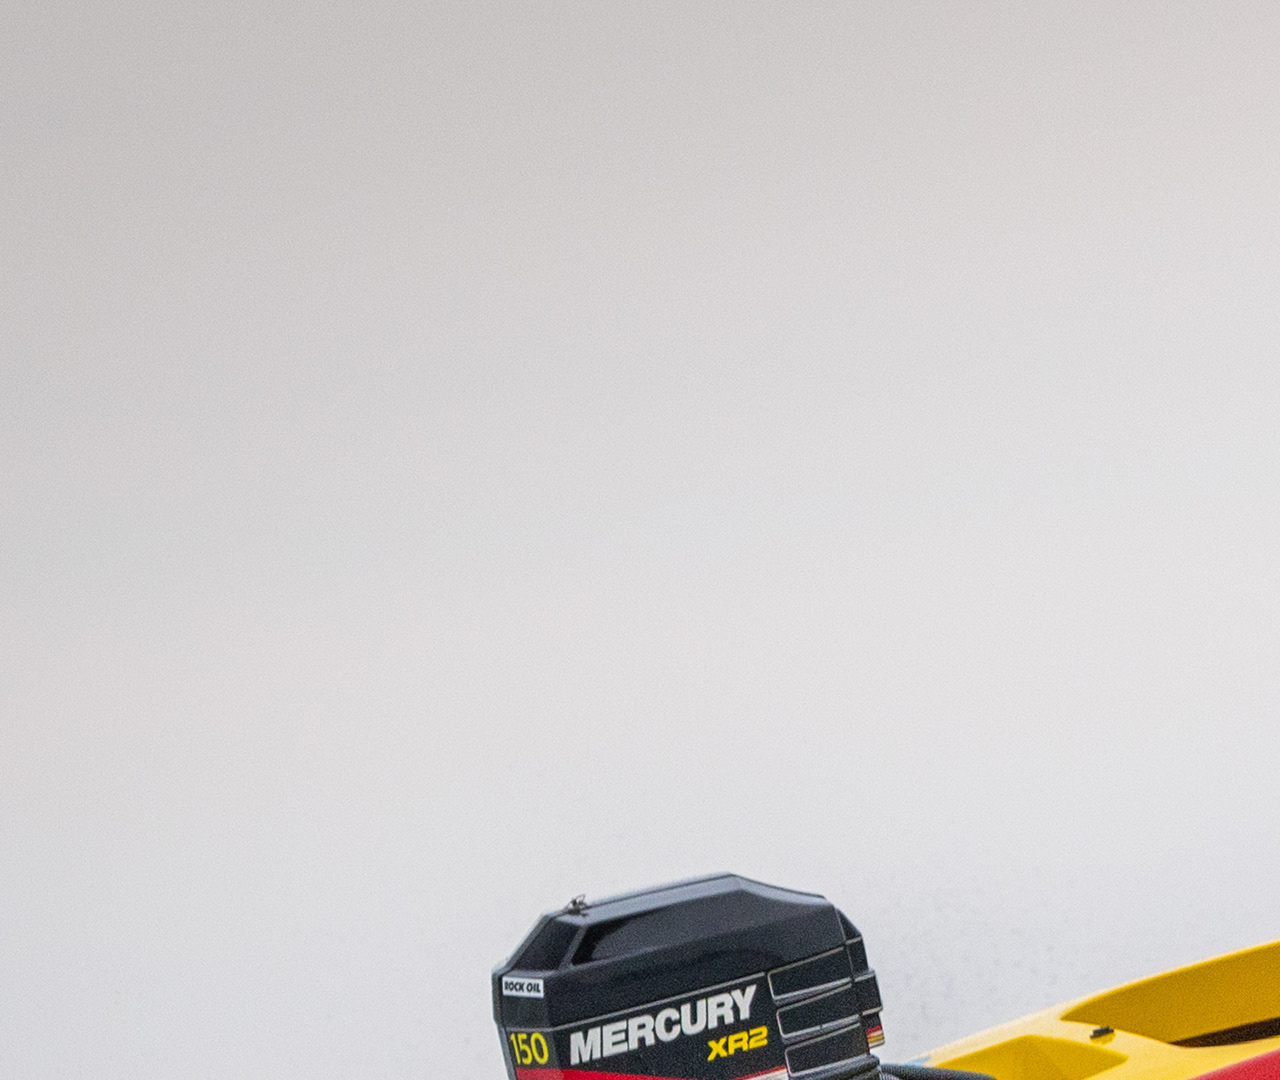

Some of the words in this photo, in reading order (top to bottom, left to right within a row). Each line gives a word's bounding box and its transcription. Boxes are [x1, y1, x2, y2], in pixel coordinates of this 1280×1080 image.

[504, 981, 525, 992] ROCK
[526, 982, 541, 993] OIL
[570, 985, 757, 1066] MERCURY
[510, 1032, 549, 1065] 150
[707, 1026, 768, 1062] XR2
